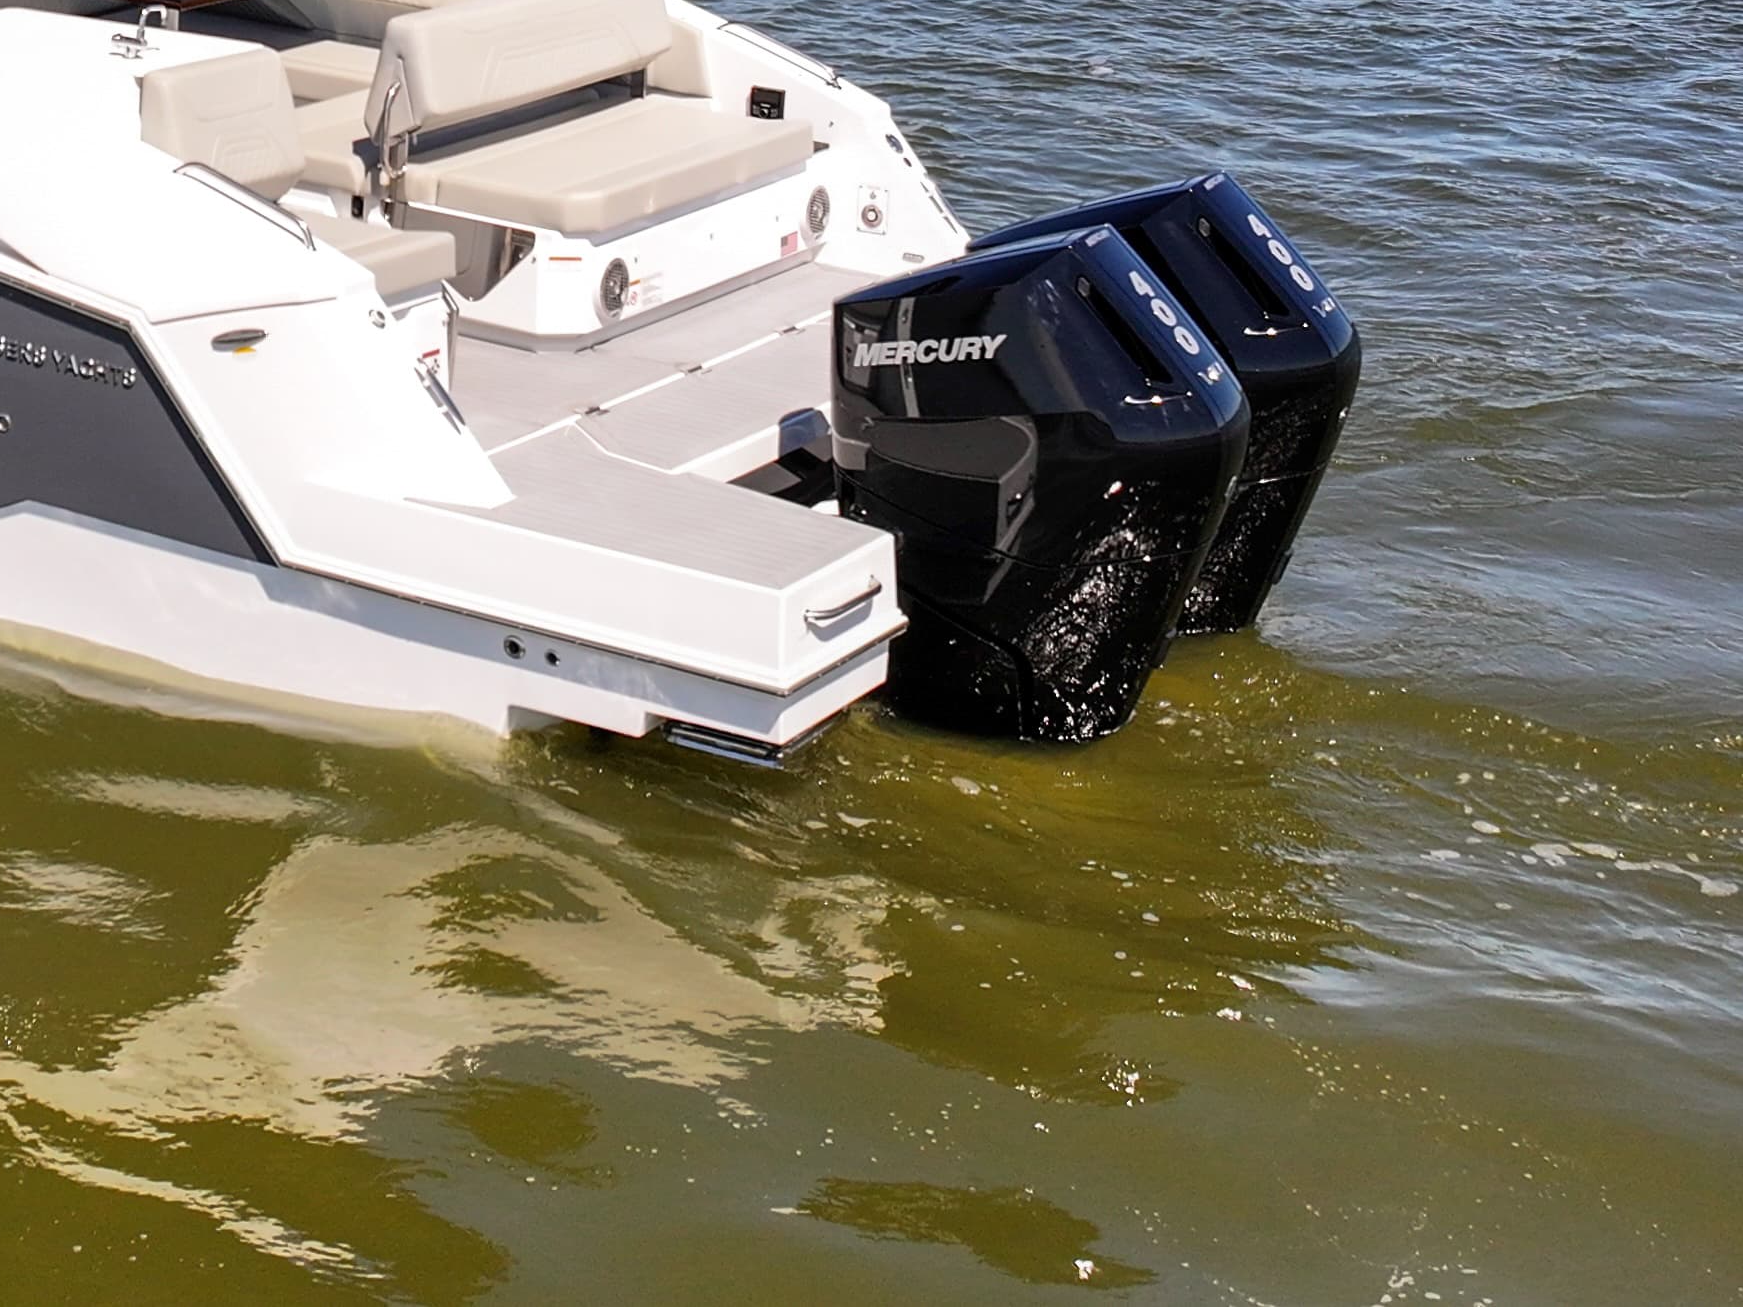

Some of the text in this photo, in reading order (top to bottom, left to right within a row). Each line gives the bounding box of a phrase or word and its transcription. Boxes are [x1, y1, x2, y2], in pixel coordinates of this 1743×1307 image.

[1247, 213, 1314, 292] 400
[853, 334, 1008, 367] MERCURY
[1128, 270, 1200, 355] 400
